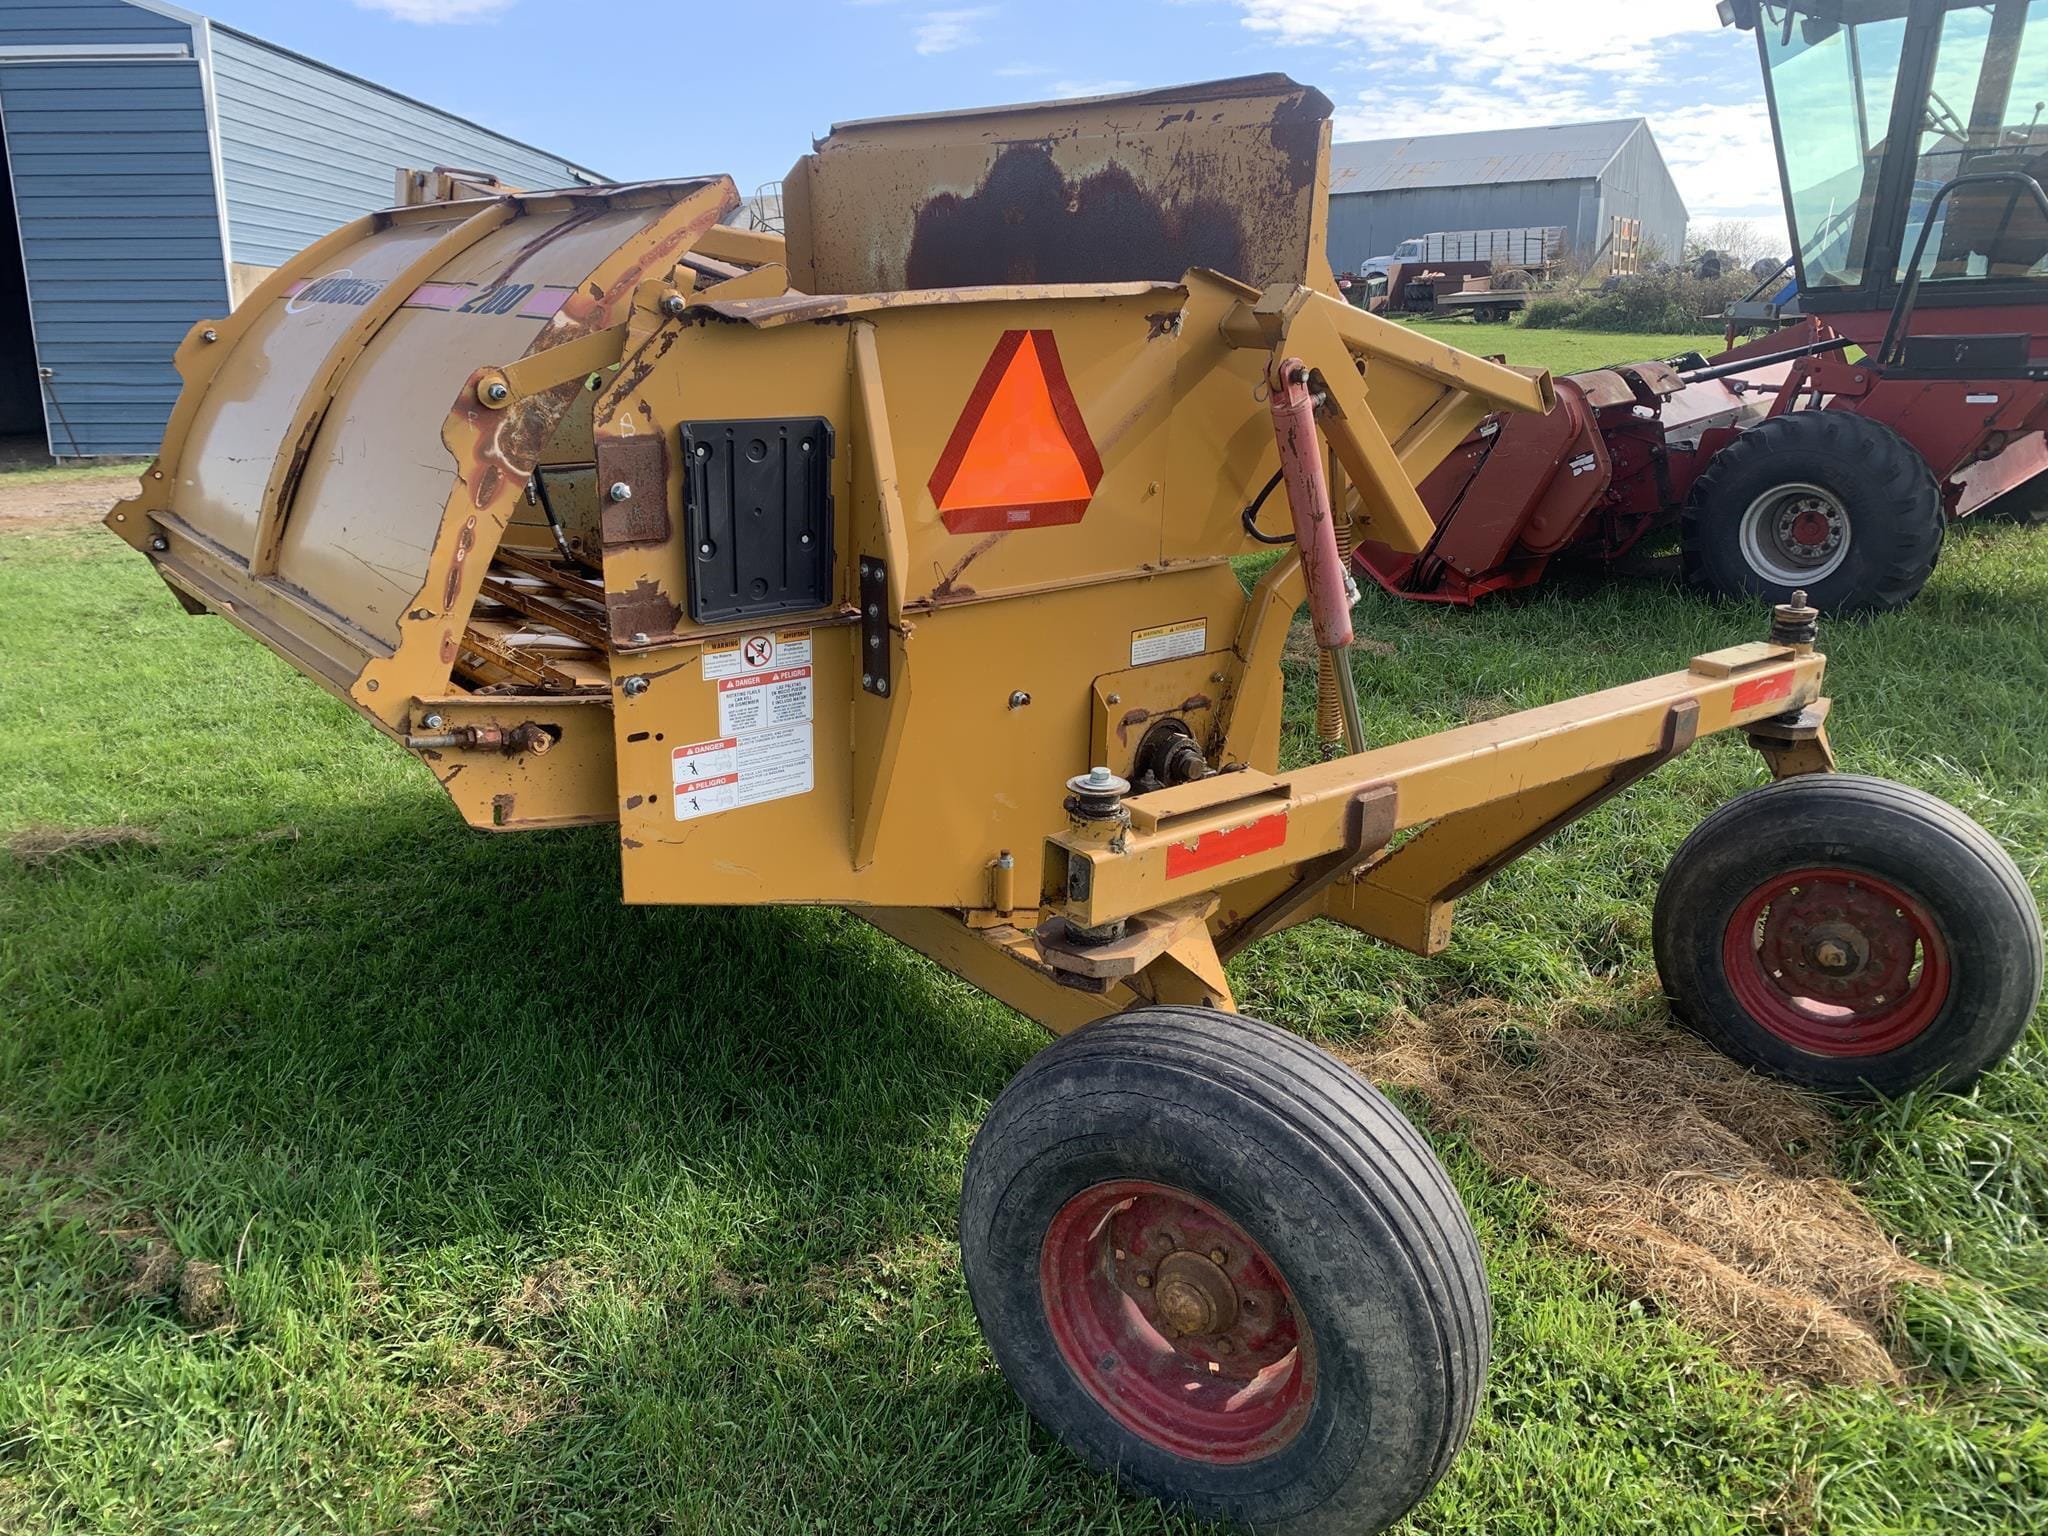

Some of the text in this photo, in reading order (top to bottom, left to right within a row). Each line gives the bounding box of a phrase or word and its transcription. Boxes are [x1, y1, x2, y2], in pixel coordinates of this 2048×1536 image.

[712, 640, 738, 649] WARNING
[735, 669, 806, 687] DANGER PELIGRO
[695, 742, 725, 753] DANGER
[696, 778, 726, 789] PELIGRO
